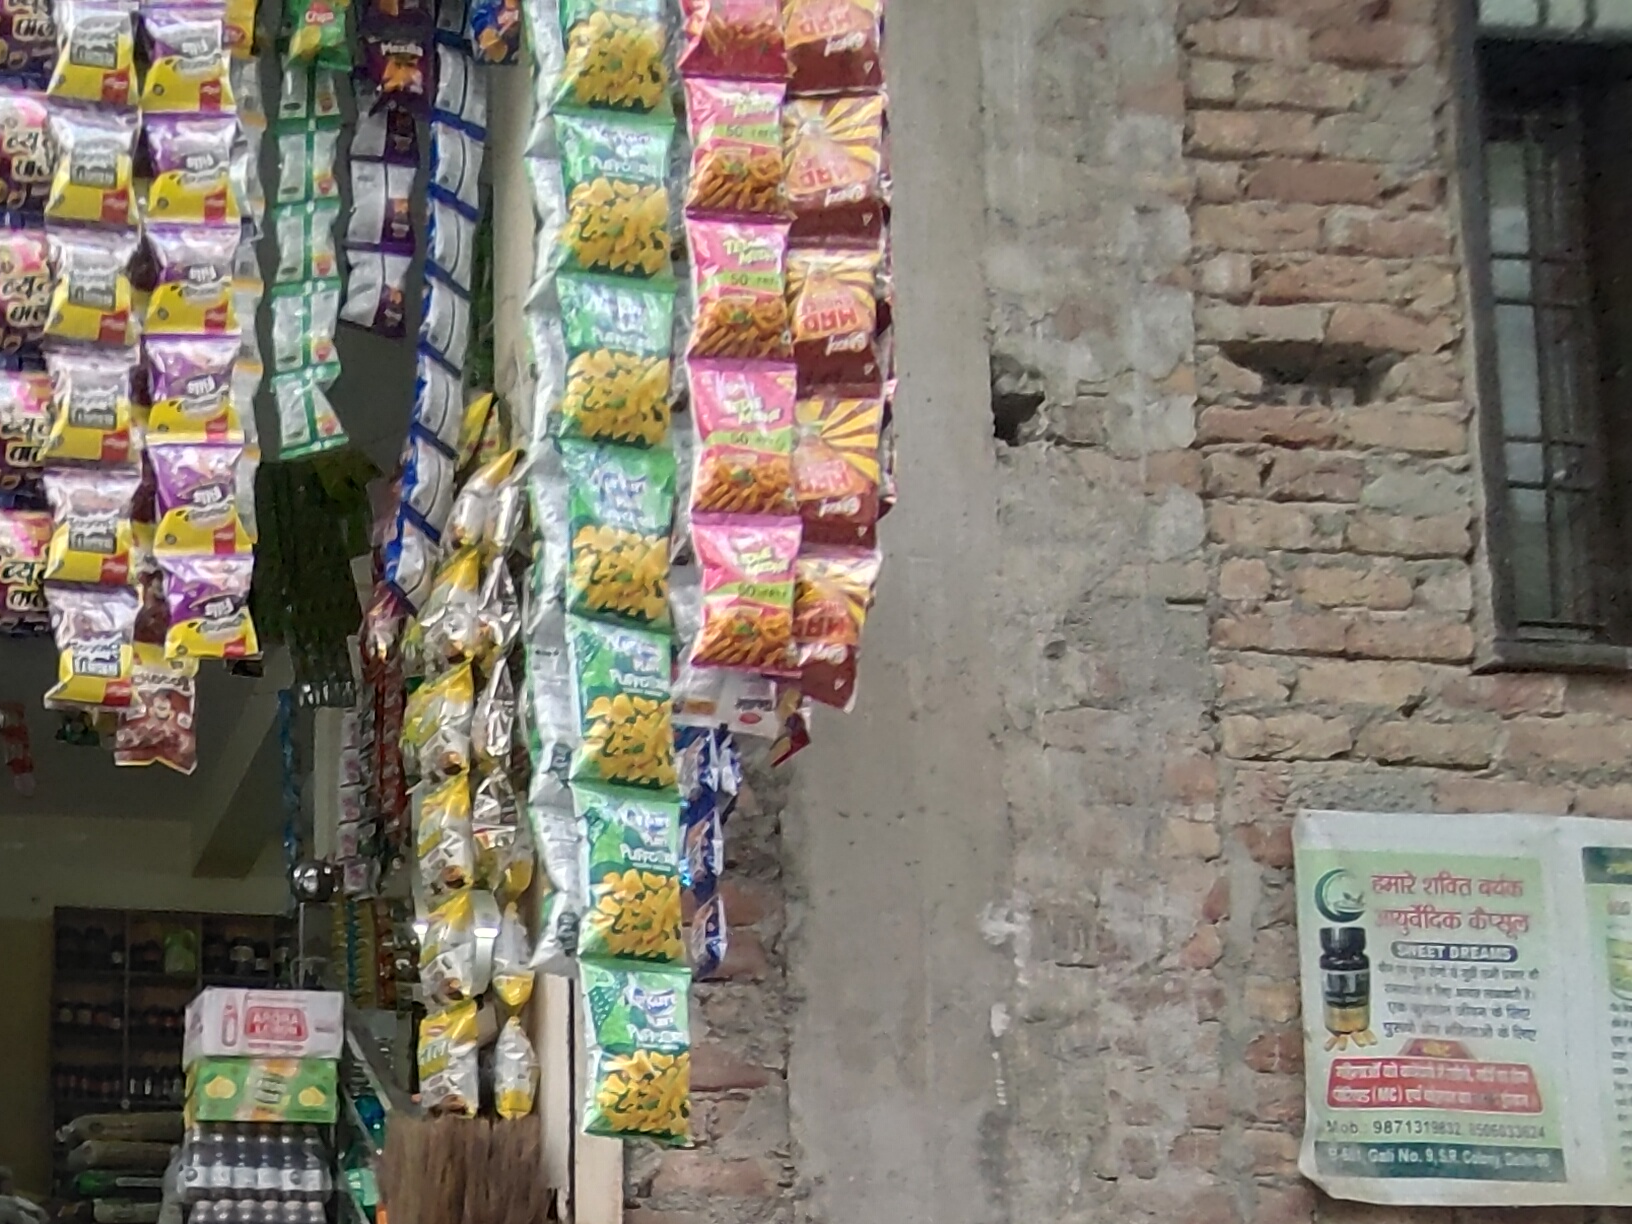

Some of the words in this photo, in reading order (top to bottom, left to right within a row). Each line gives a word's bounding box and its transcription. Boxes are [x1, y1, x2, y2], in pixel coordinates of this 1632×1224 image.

[1397, 945, 1445, 959] SWEET
[1449, 946, 1512, 960] DREAMS
[1398, 1149, 1423, 1163] No.
